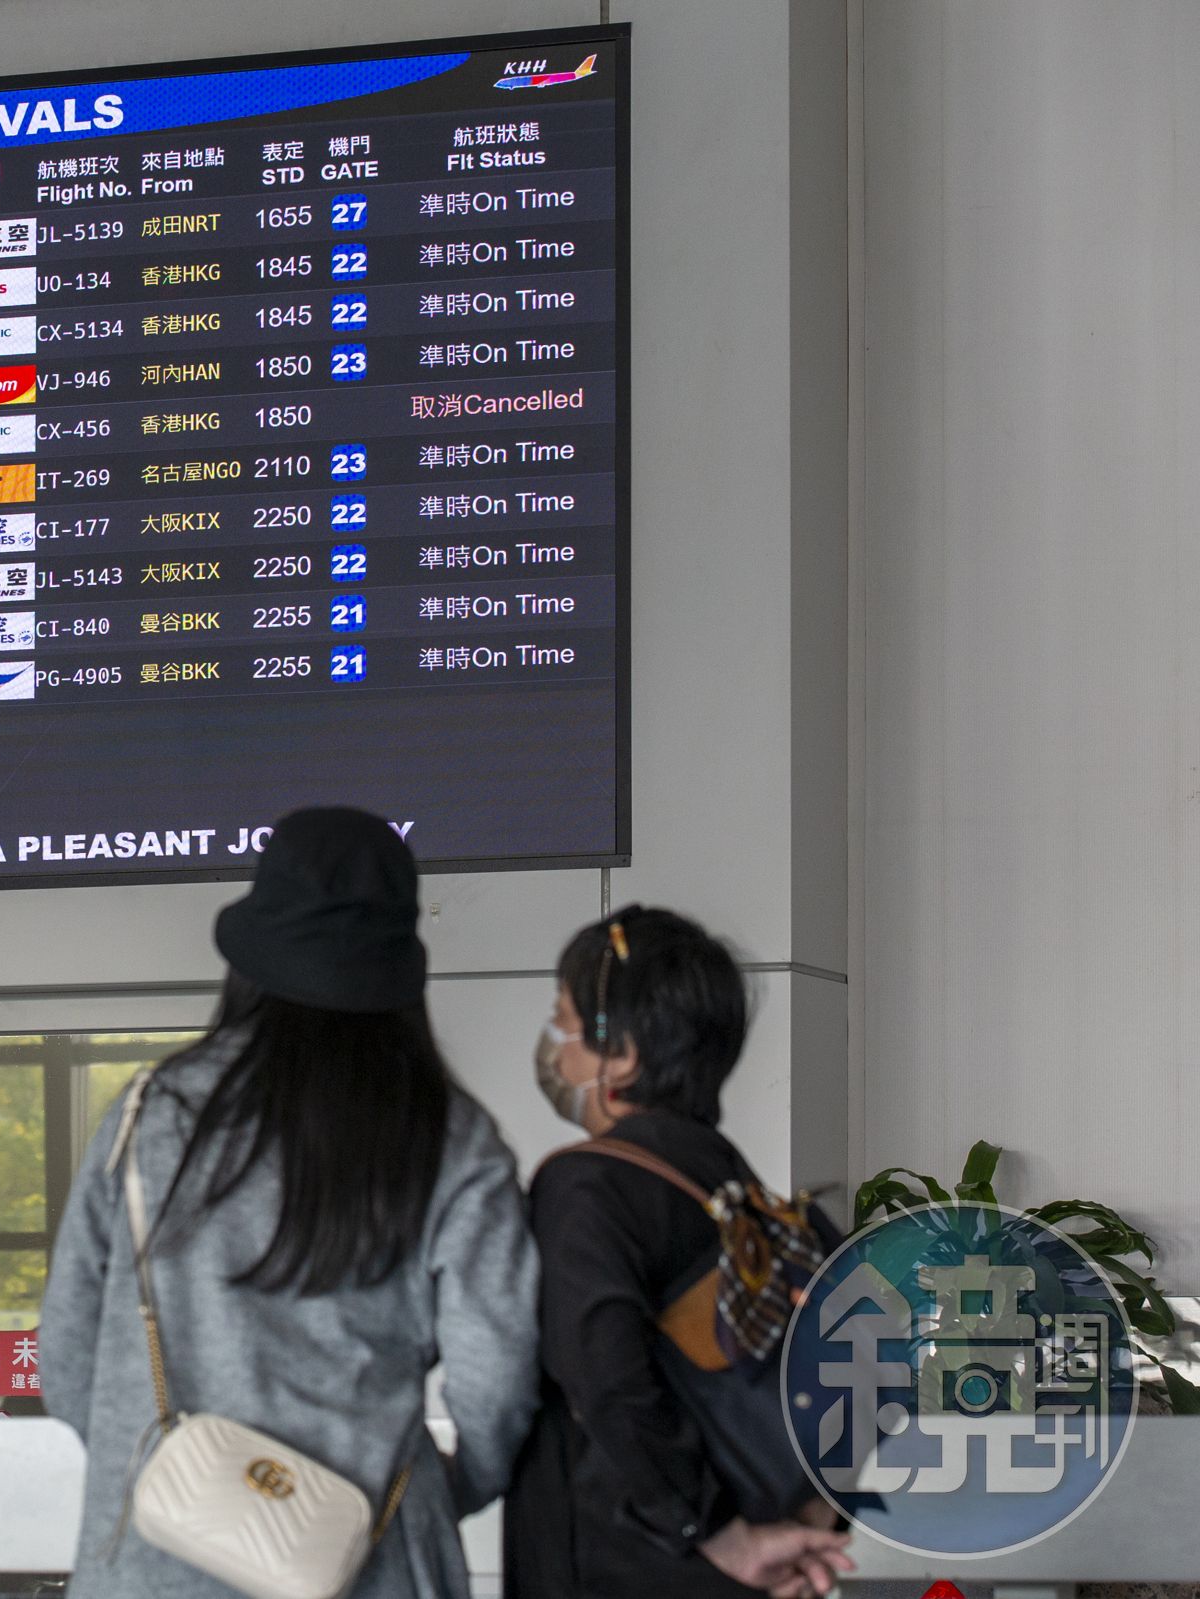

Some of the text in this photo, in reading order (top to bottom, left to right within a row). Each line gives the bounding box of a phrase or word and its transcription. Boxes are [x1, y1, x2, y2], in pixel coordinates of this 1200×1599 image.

[503, 59, 547, 74] KHH
[454, 122, 539, 146] 航班狀態
[263, 141, 303, 161] 表定
[329, 136, 369, 157] 機門
[38, 156, 119, 179] 航機班次
[142, 147, 224, 171] 來自地點
[322, 161, 378, 180] GATE
[448, 150, 545, 171] Flt Status
[142, 178, 192, 194] From
[263, 167, 304, 185] STD
[38, 181, 131, 204] Flight No.
[255, 205, 313, 229] 1655
[332, 201, 367, 224] 27
[36, 220, 124, 245] JL-5139
[141, 213, 222, 238] 成田NRT
[255, 255, 313, 279] 1845
[332, 252, 367, 274] 22
[36, 271, 112, 293] UO-134
[141, 263, 221, 287] 香港HKG
[141, 312, 221, 337] 香港HKG
[255, 304, 313, 329] 1845
[331, 302, 367, 324] 22
[36, 319, 124, 342] CX-5134
[141, 362, 221, 385] 河內HAN
[255, 354, 312, 379] 1850
[331, 352, 367, 374] 23
[36, 369, 111, 392] VJ-946
[140, 412, 221, 435] 香港HKG
[254, 405, 312, 429] 1850
[36, 419, 111, 441] CX-456
[140, 460, 242, 485] 名古屋NGO
[253, 455, 311, 479] 2110
[331, 452, 366, 474] 23
[36, 468, 111, 491] IT-269
[140, 511, 221, 535] 大阪KIX
[252, 505, 312, 529] 2250
[331, 503, 367, 525] 22
[35, 517, 111, 540] CI-177
[140, 561, 221, 584] 大阪KIX
[253, 555, 312, 579] 2250
[331, 553, 367, 575] 22
[35, 567, 123, 589] JL-5143
[139, 611, 221, 634] 曼谷BKK
[252, 605, 312, 629] 2255
[331, 603, 363, 625] 21
[35, 617, 111, 638] CI-840
[139, 661, 221, 684] 曼谷BKK
[252, 655, 312, 679] 2255
[331, 654, 363, 676] 21
[35, 666, 122, 688] PG-4905
[19, 830, 215, 861] PLEASANT
